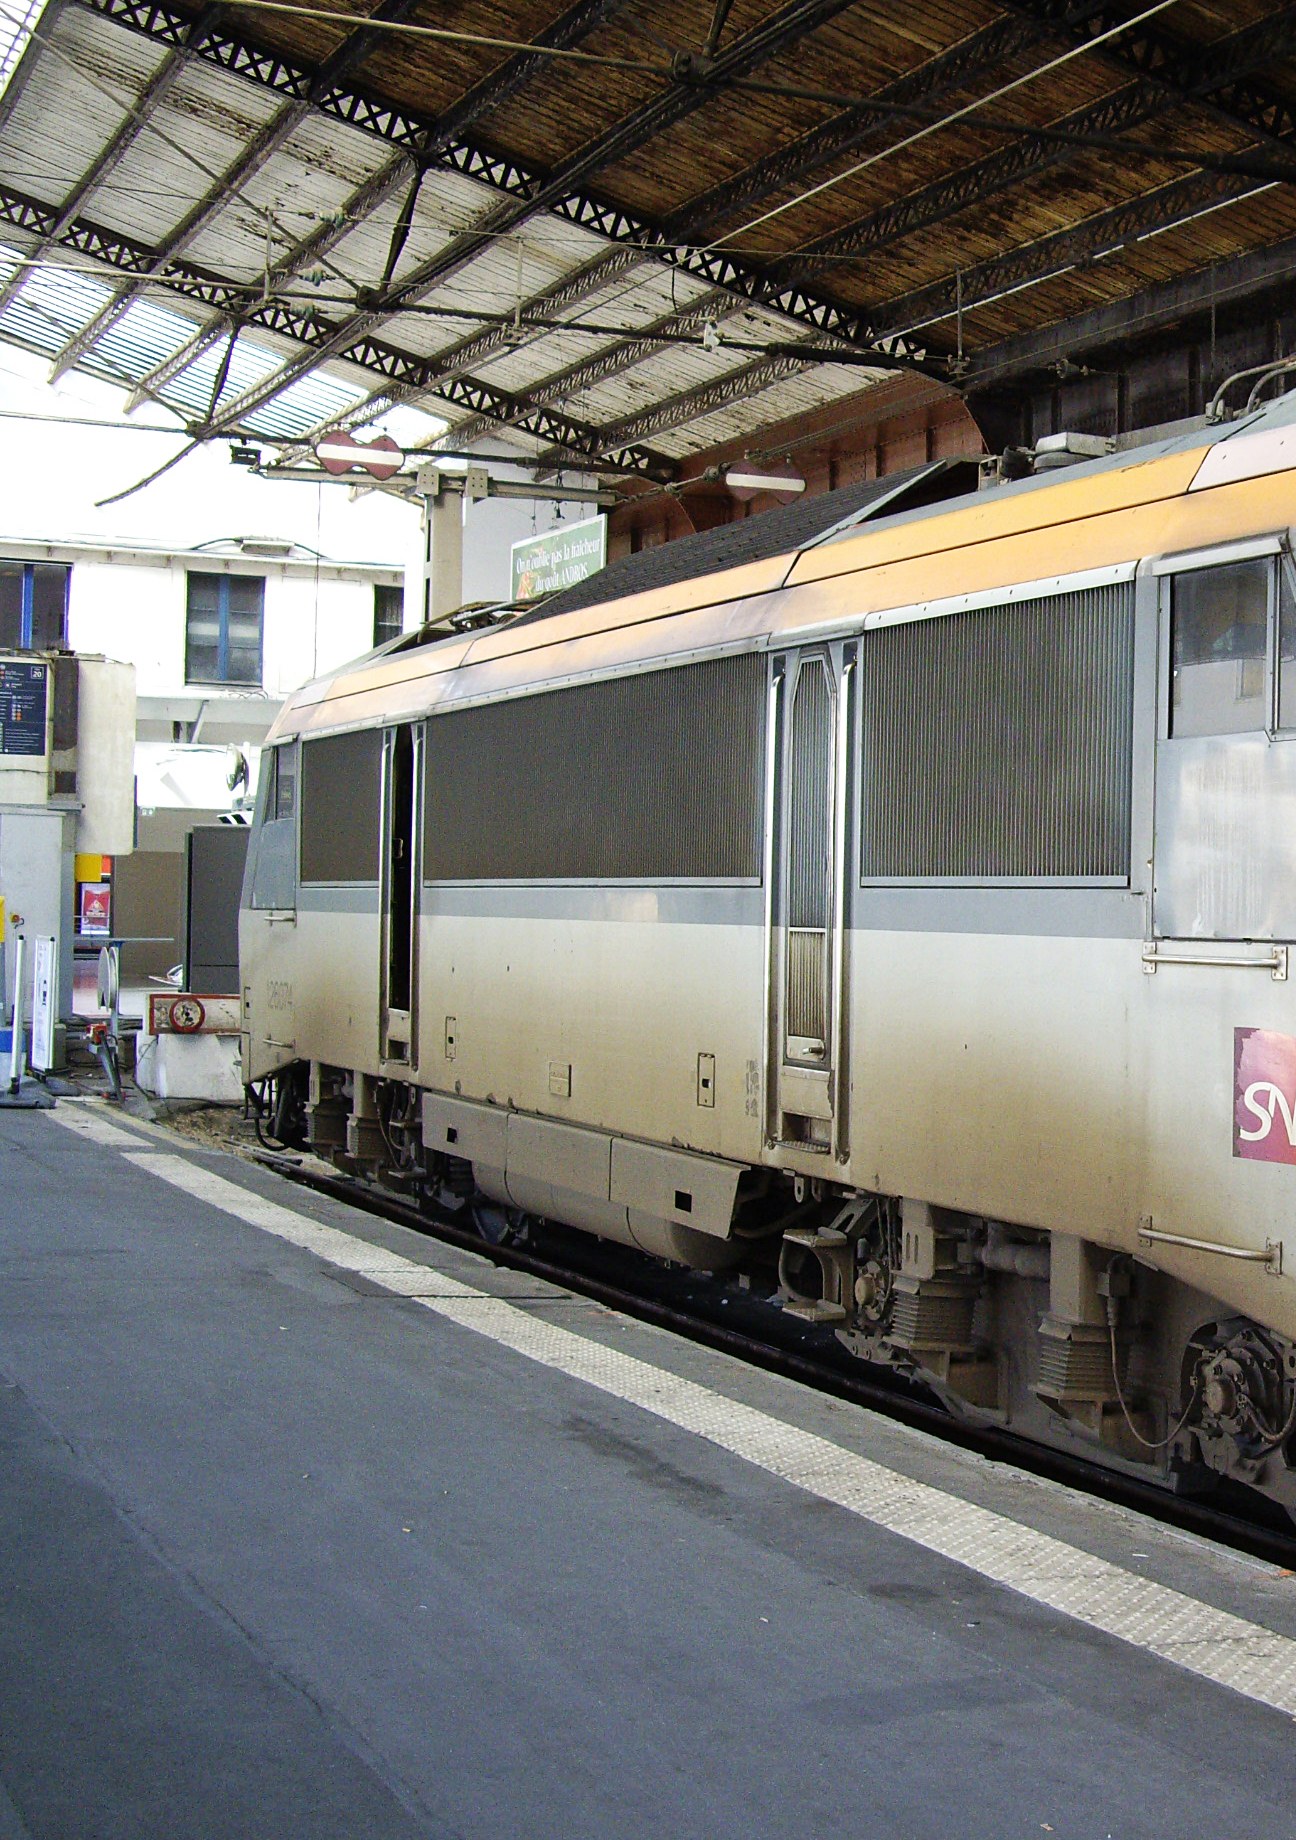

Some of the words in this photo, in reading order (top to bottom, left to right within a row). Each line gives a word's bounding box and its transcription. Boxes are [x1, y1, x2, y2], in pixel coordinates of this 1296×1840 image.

[551, 550, 563, 569] pas
[563, 543, 570, 561] la
[535, 575, 544, 592] du
